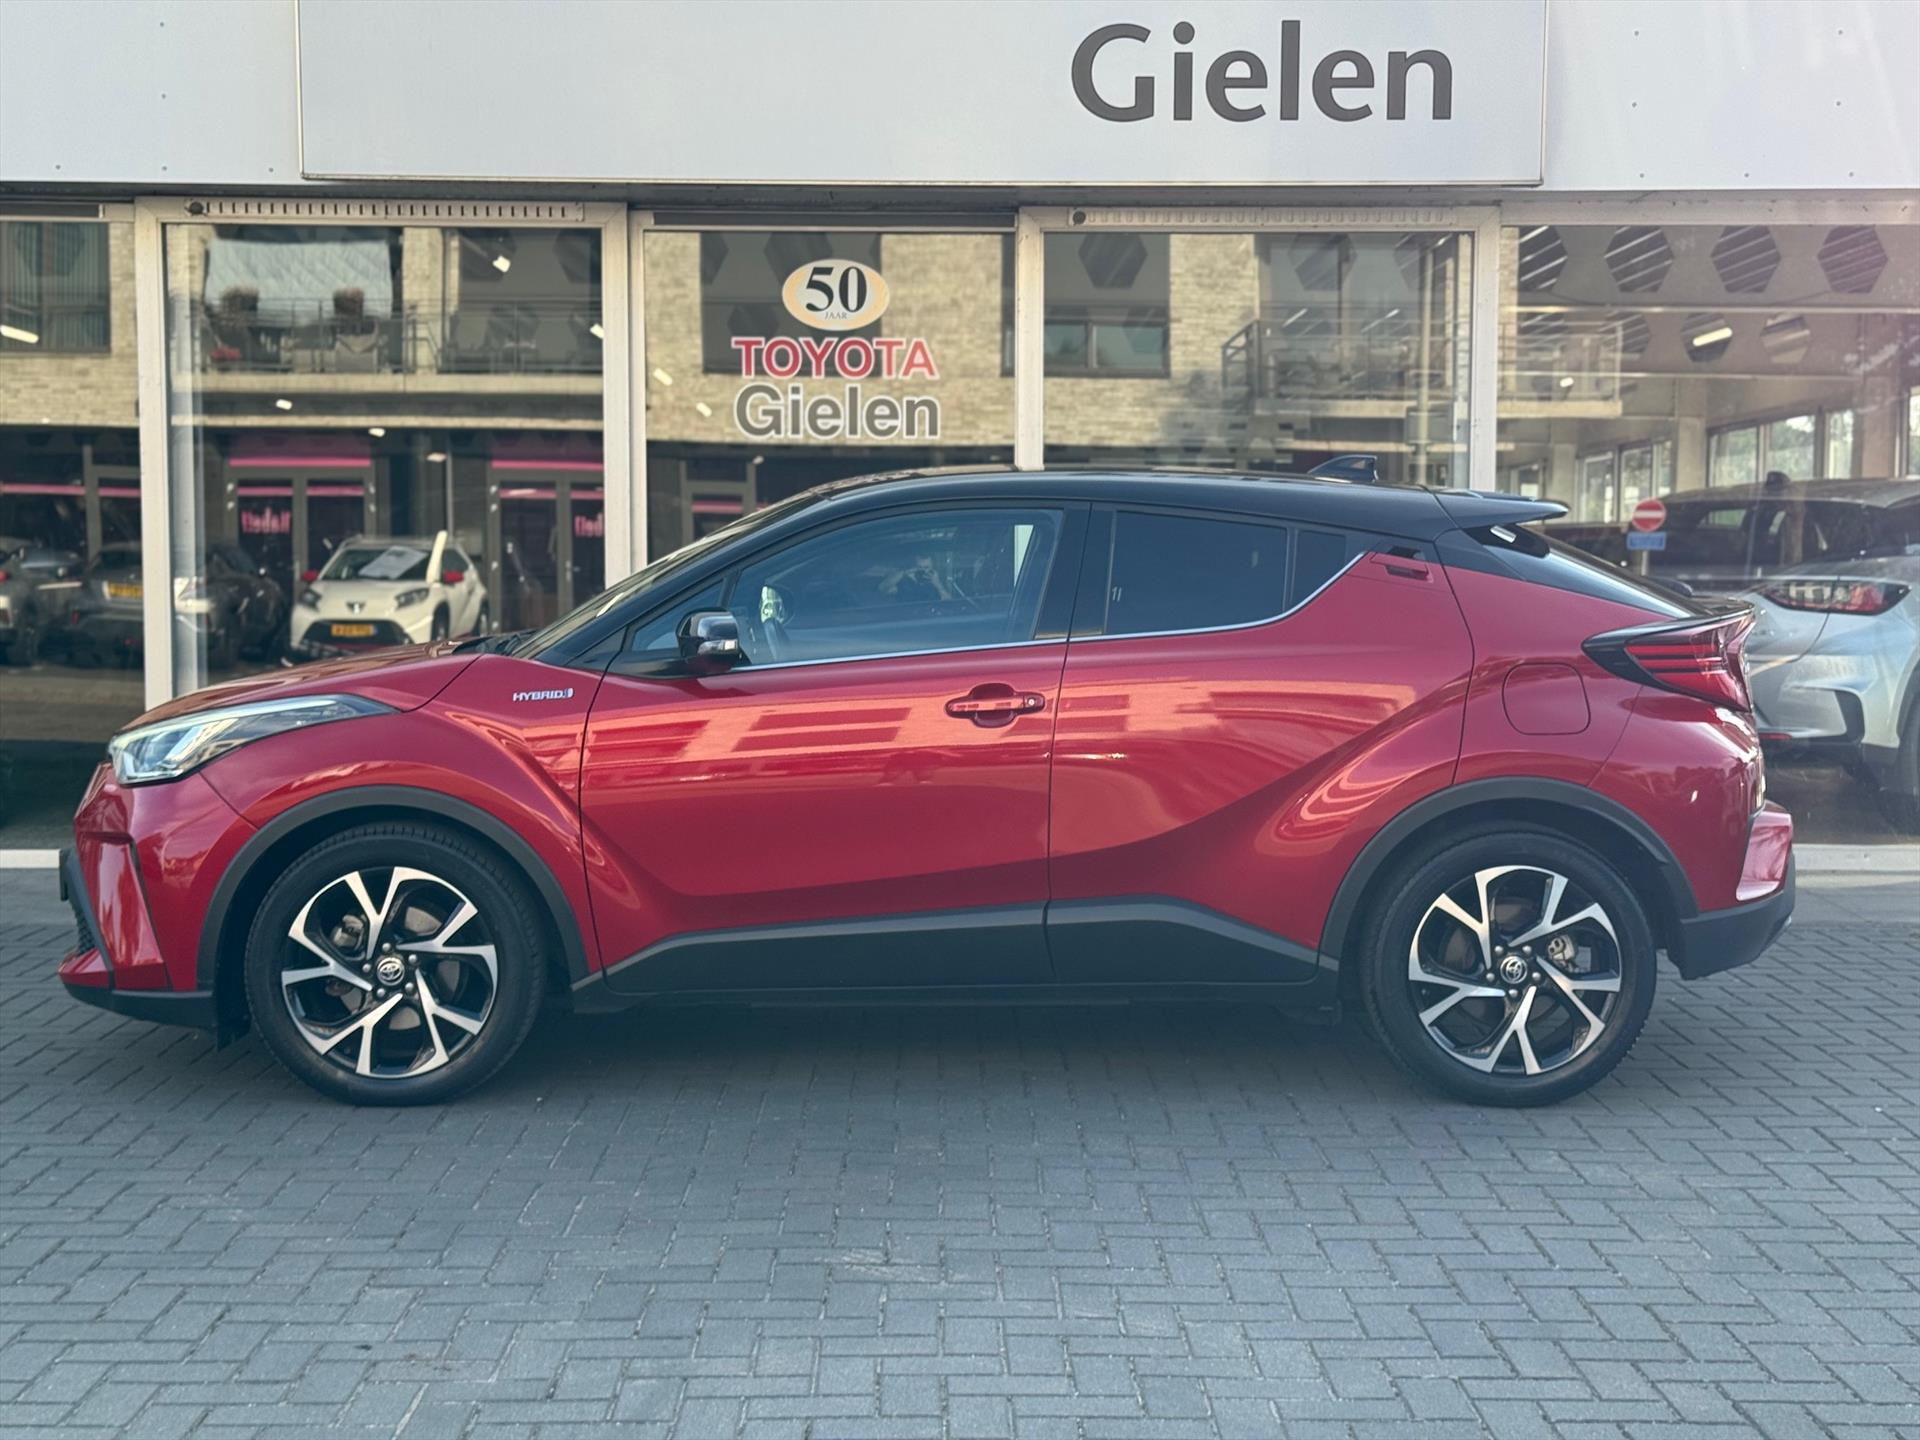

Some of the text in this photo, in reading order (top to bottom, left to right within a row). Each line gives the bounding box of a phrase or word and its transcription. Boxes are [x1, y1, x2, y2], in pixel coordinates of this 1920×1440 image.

[1071, 19, 1453, 122] Gielen
[805, 266, 868, 313] 50
[824, 311, 848, 321] JAAR
[732, 338, 939, 379] TOYOTA
[735, 383, 940, 438] Gielen
[512, 689, 564, 702] HYBRID
